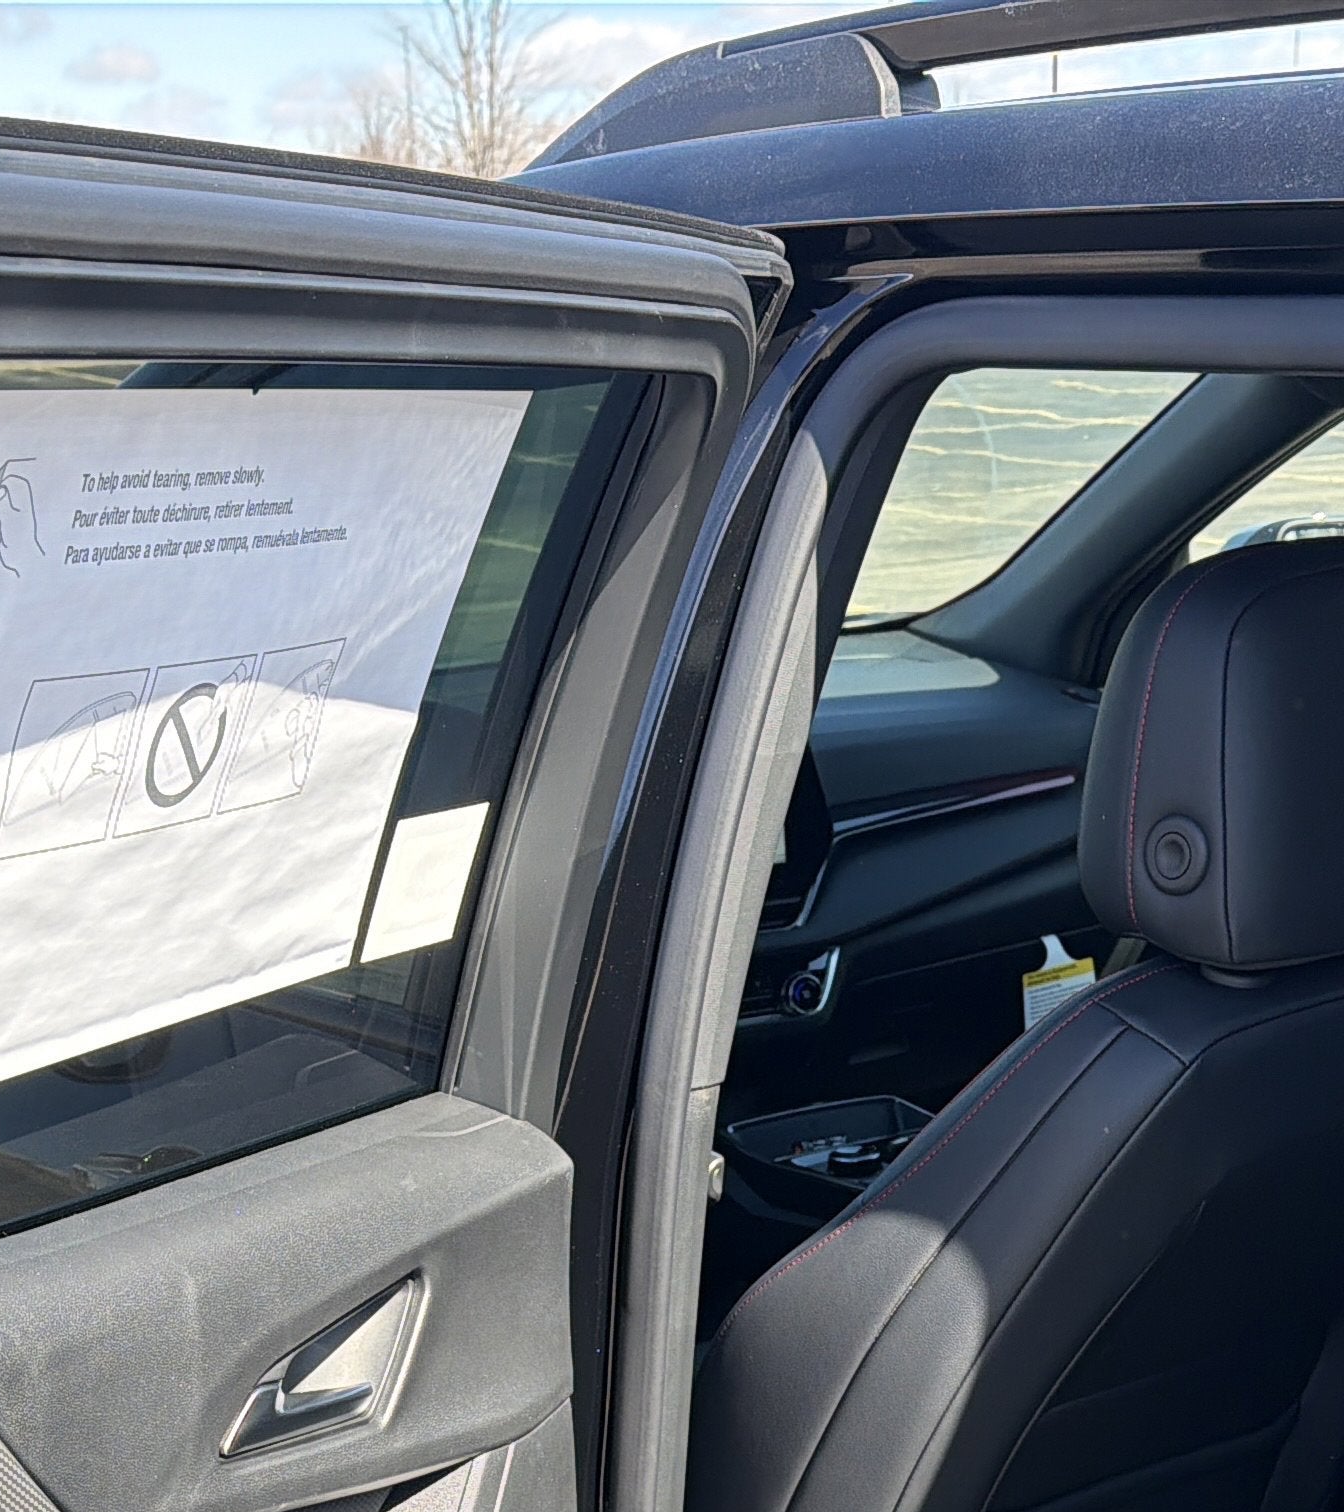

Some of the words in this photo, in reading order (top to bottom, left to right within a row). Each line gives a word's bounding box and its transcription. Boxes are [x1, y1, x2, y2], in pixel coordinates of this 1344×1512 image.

[82, 473, 96, 492] To
[97, 471, 119, 494] help
[121, 469, 151, 489] avoid
[153, 469, 192, 491] tearing,
[194, 470, 231, 487] remove
[232, 466, 265, 487] slowly.
[72, 510, 98, 528] Pour
[99, 506, 130, 526] éviter
[131, 505, 160, 524] toute
[162, 503, 212, 523] déchirure,
[214, 500, 245, 519] retirer
[64, 545, 89, 565] Para
[92, 542, 142, 566] ayudarse
[143, 543, 152, 558] a
[153, 538, 183, 558] evitar
[183, 540, 202, 558] que
[203, 539, 216, 552] se
[217, 535, 249, 554] rompa,
